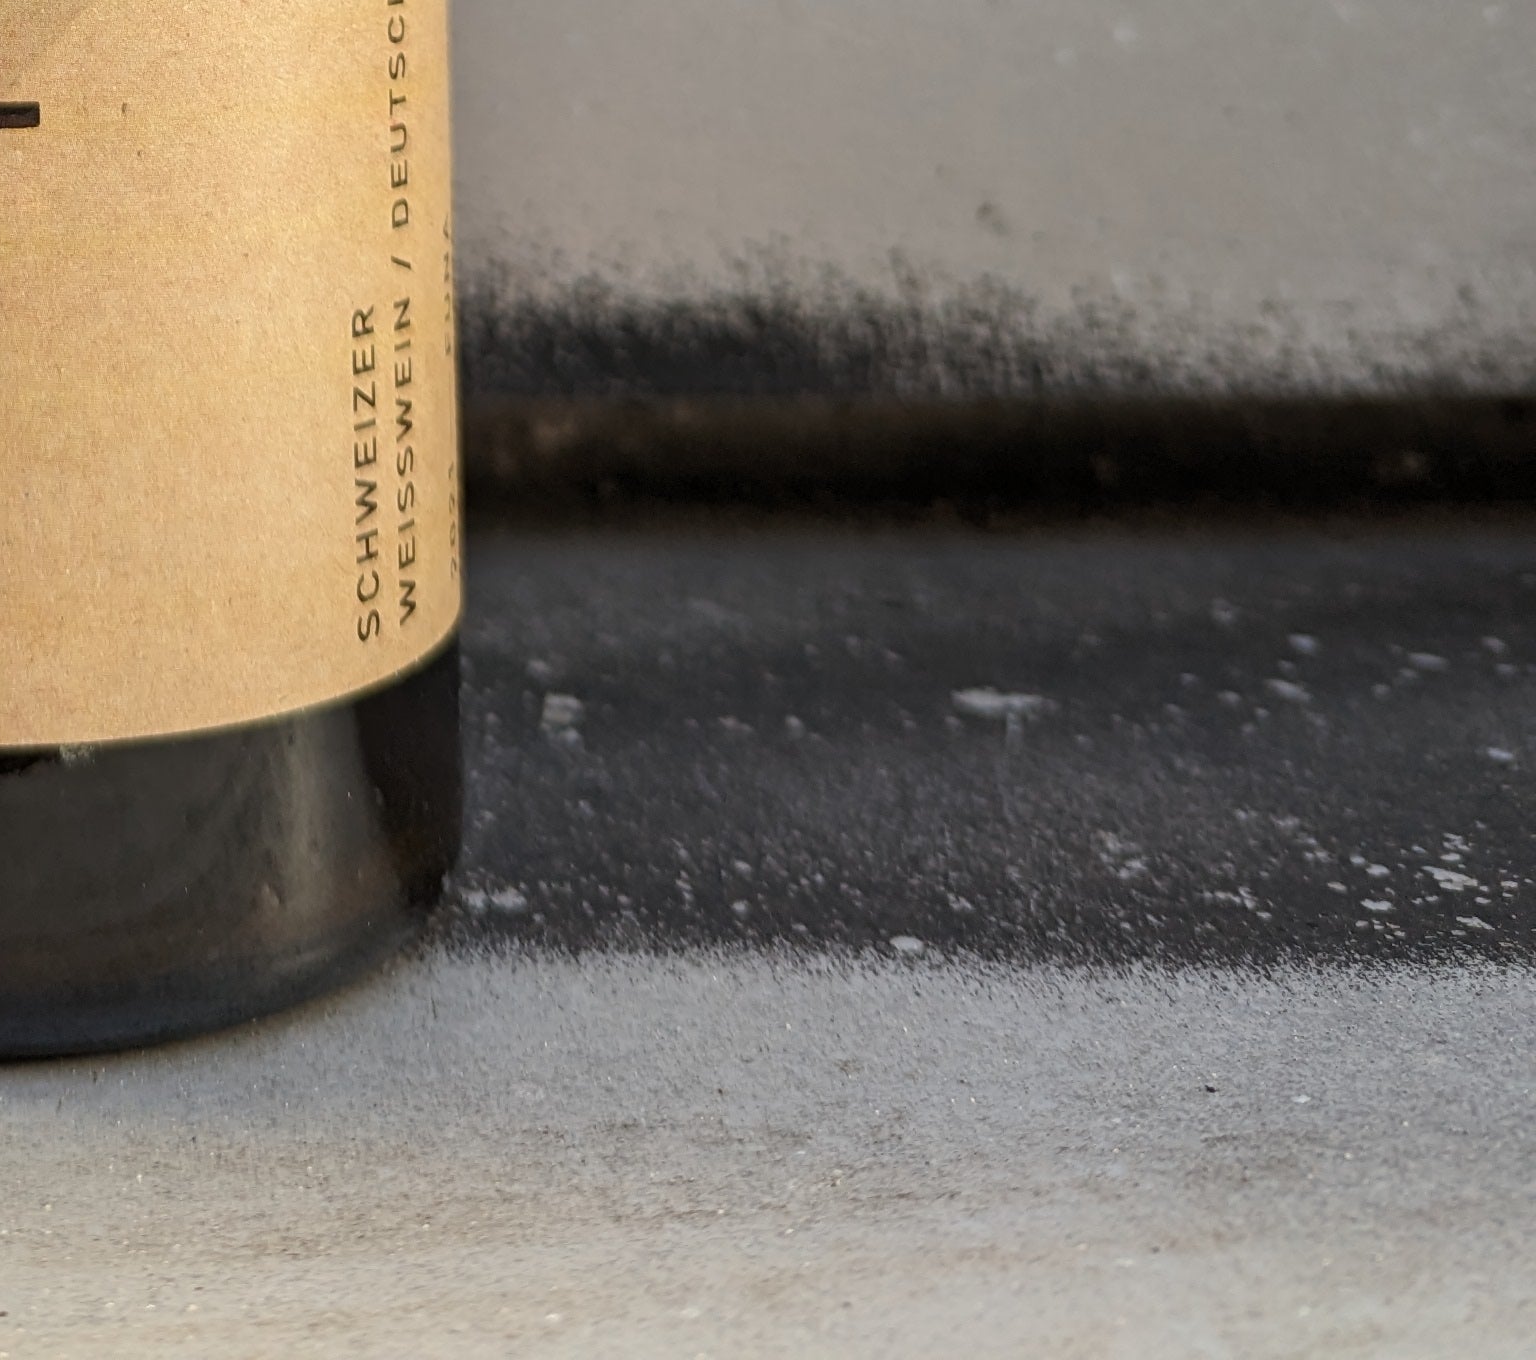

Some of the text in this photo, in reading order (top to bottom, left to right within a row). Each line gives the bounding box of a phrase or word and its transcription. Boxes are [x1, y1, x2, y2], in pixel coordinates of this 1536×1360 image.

[390, 254, 413, 271] /
[351, 304, 381, 643] SCHWEIZER
[392, 296, 418, 627] WEISSWEIN
